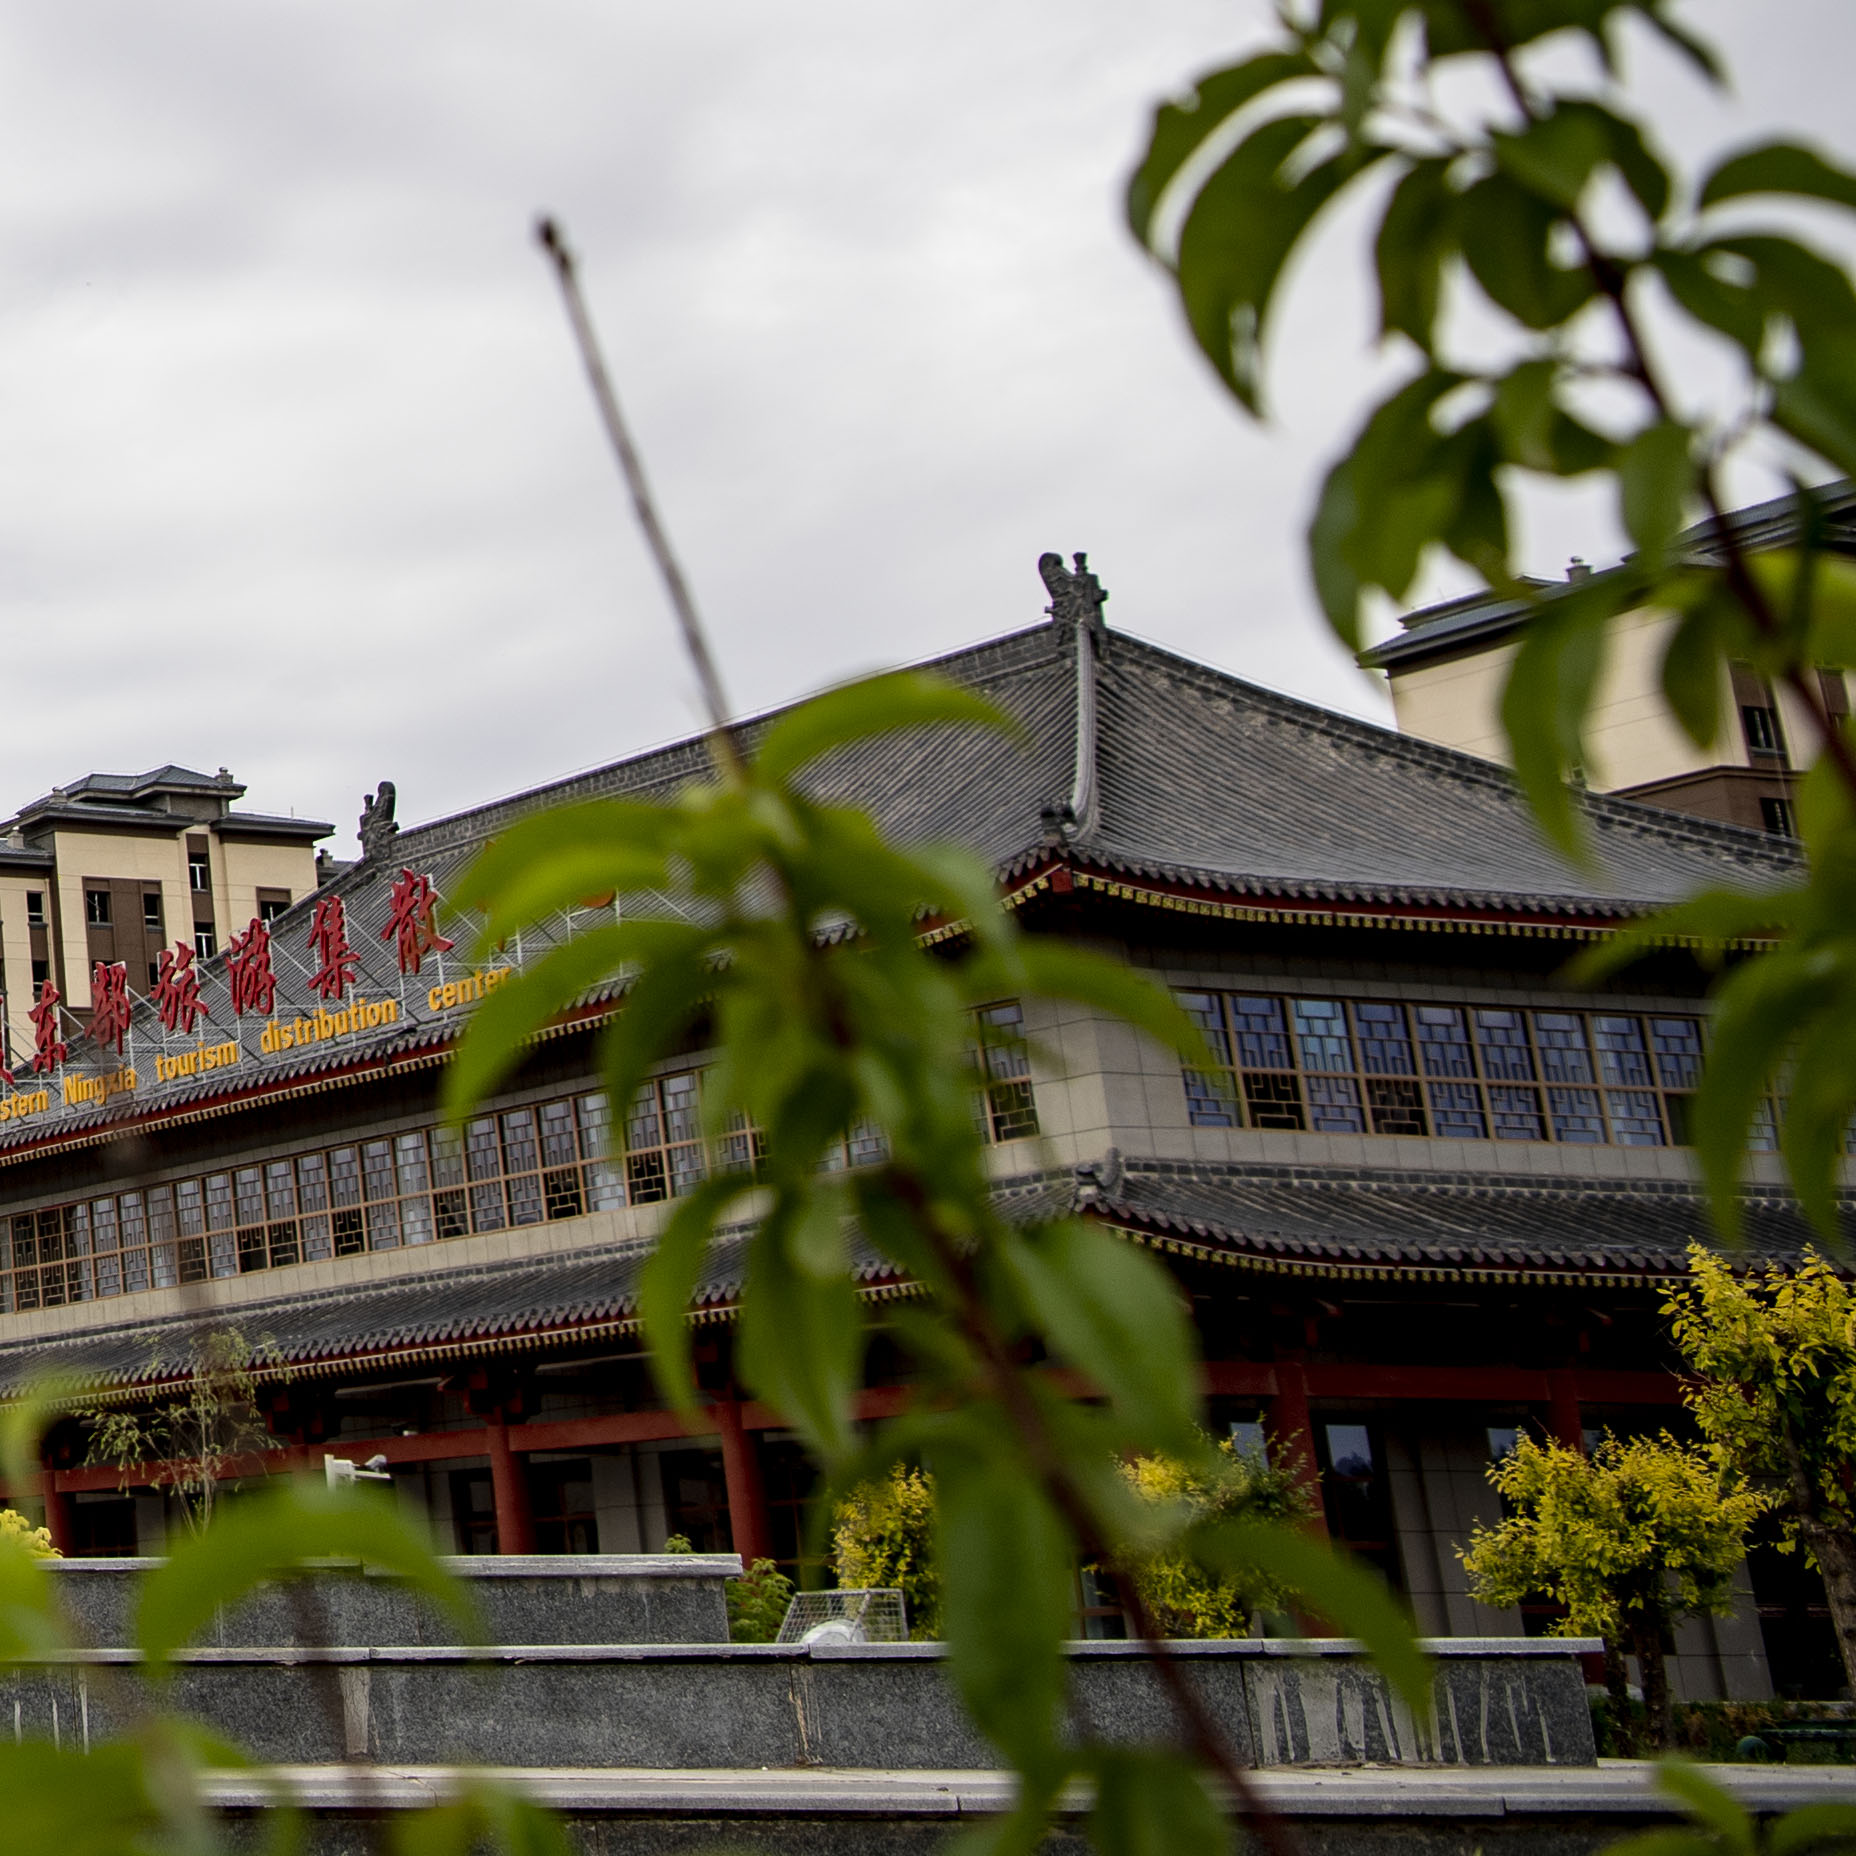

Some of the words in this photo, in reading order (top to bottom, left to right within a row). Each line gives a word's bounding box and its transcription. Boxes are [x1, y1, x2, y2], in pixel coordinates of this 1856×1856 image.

[63, 1064, 136, 1106] Ningxia
[155, 1040, 238, 1082] tourism
[261, 998, 398, 1055] distribution
[428, 967, 512, 1012] center
